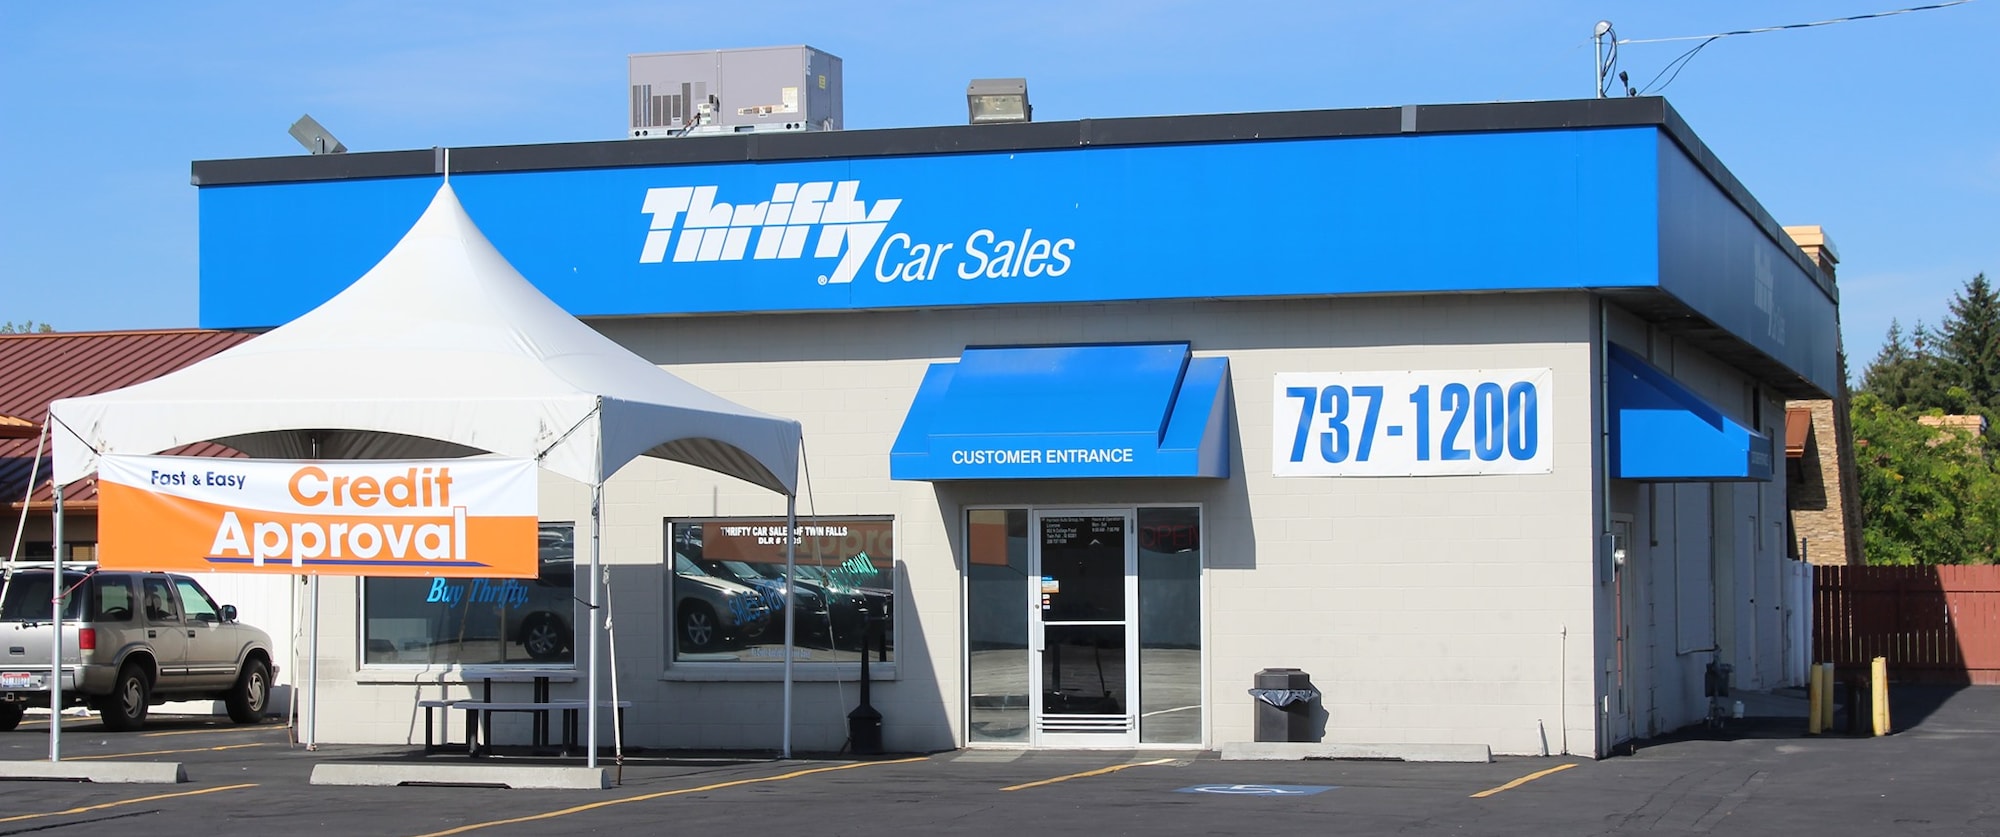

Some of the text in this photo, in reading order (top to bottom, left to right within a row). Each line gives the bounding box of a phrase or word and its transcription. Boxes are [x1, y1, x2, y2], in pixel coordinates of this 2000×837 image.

[639, 180, 903, 284] Thrifty
[875, 228, 1076, 283] Car Sales
[1286, 381, 1538, 463] 737-1200
[951, 448, 1133, 464] CUSTOMER ENTRANCE
[151, 470, 246, 490] Fast & Easy
[288, 466, 453, 508] Credit
[209, 506, 467, 567] Approval
[720, 526, 751, 536] THRIFTY
[752, 526, 767, 537] CAR
[768, 526, 791, 536] SALE
[804, 526, 824, 536] TWIN
[825, 526, 848, 537] FALLS
[758, 537, 774, 545] DLR
[775, 537, 781, 545] #
[426, 577, 464, 609] Buy
